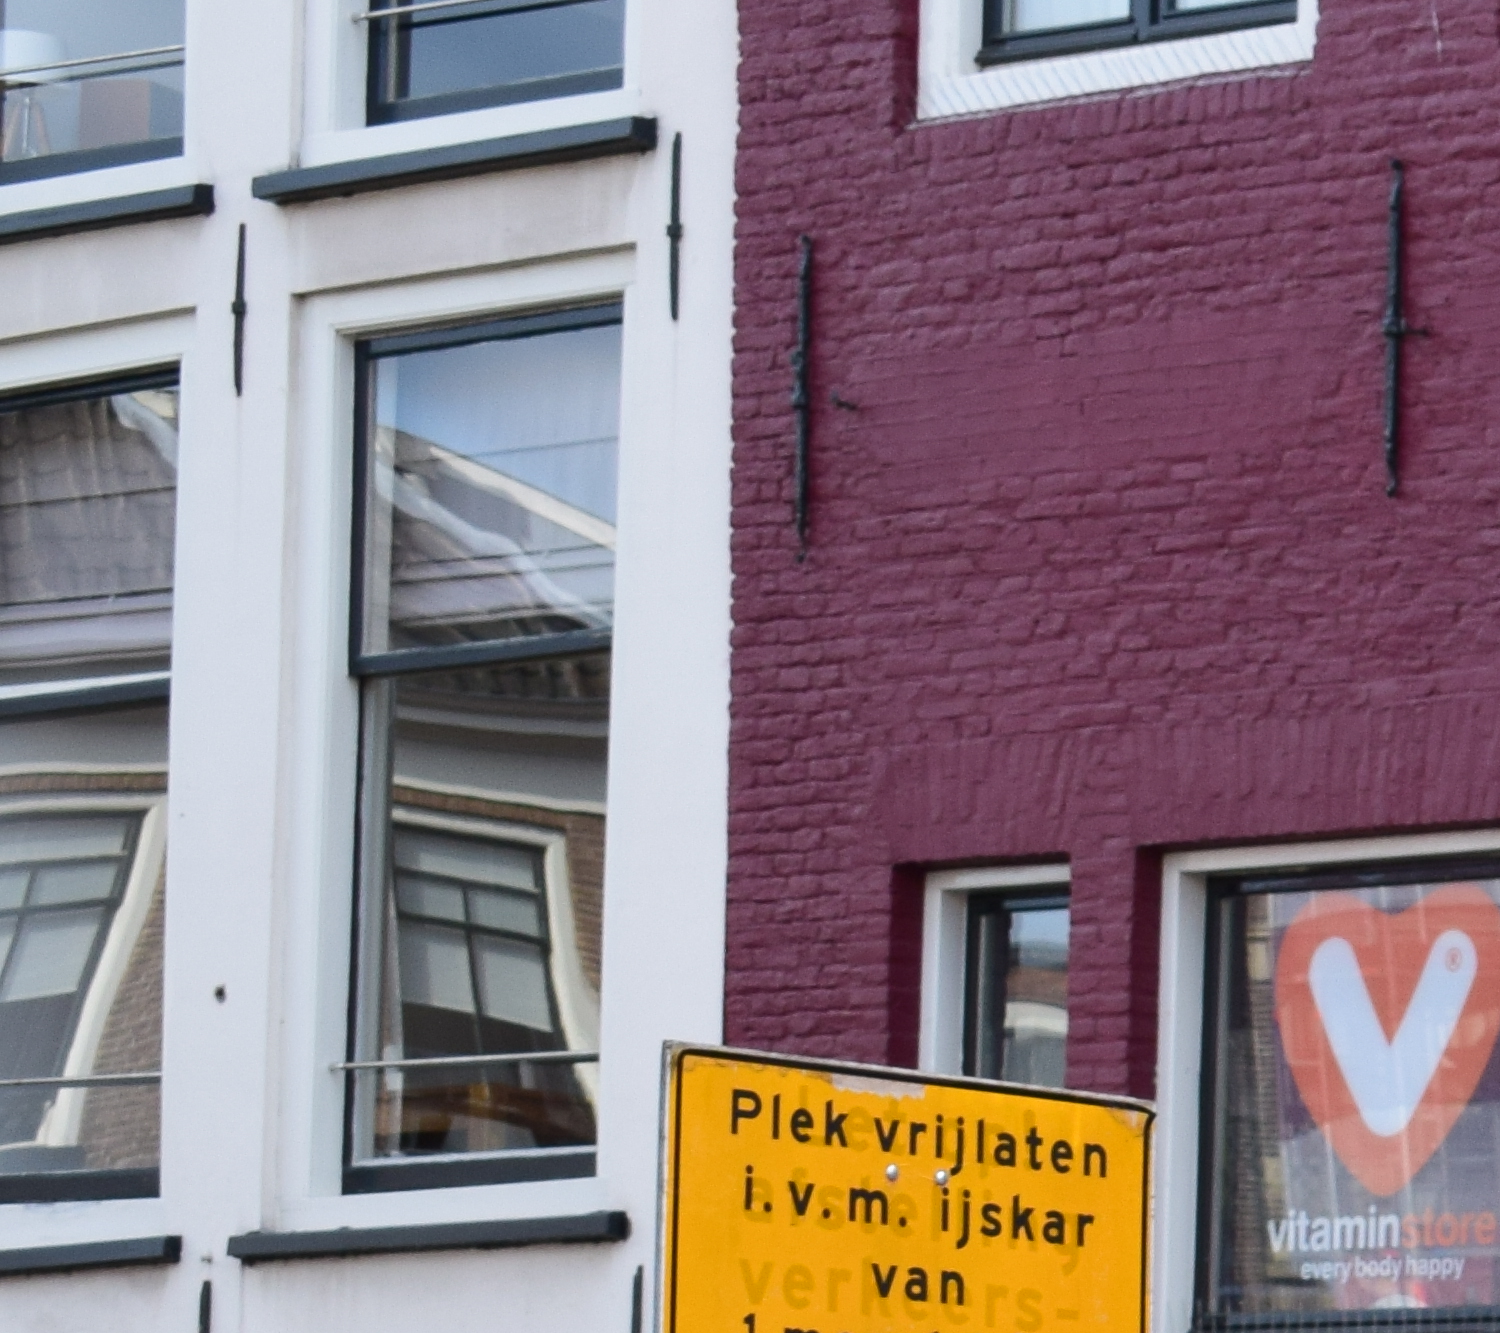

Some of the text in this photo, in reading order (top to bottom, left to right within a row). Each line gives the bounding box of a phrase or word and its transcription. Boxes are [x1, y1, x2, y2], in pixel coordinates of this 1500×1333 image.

[729, 1089, 1109, 1178] Plek vrijlaten
[743, 1165, 1096, 1249] i.v.m. ijskar
[1266, 1204, 1498, 1253] vitaminstore
[871, 1262, 967, 1306] van
[1300, 1255, 1465, 1283] every body happy
